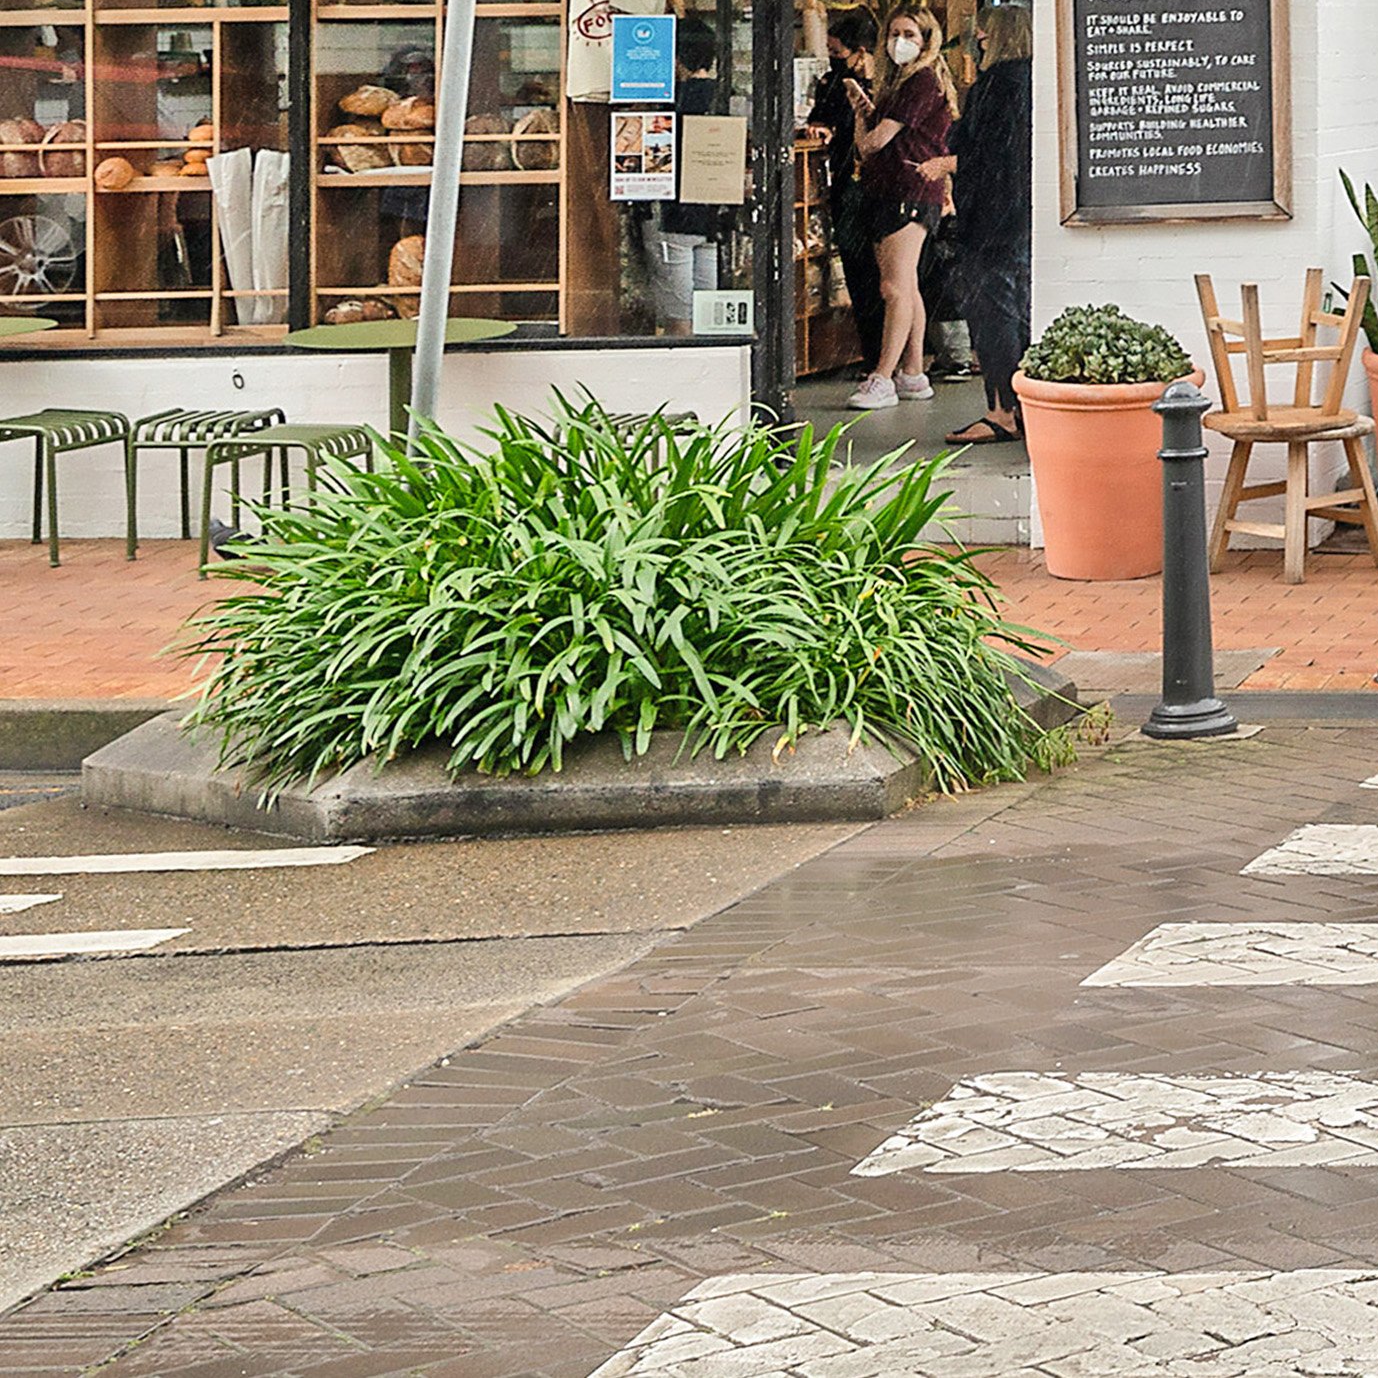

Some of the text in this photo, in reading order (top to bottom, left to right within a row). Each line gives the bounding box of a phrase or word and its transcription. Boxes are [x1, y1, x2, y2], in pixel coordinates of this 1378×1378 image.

[1086, 10, 1244, 26] IT SHOULD BE ENJOYABLE TO
[1086, 26, 1107, 38] EAT
[1086, 42, 1125, 55] SIMPLE
[1130, 42, 1141, 53] IS
[1087, 54, 1257, 72] SOURCED SUSTAINABLY, TO CARE
[1088, 71, 1108, 82] FOR
[1110, 70, 1130, 81] OUR
[1088, 86, 1115, 97] KEEP
[1118, 85, 1129, 96] IT
[1164, 83, 1195, 94] AVOID
[1197, 81, 1261, 93] COMMERCIAL
[1145, 103, 1190, 115] REFINED
[1089, 116, 1249, 133] SUPPORTS BUILDING HEALTHIER
[1089, 147, 1140, 159] PROMOTES
[1142, 145, 1175, 157] LOCAL
[1177, 143, 1203, 156] FOOD
[1088, 164, 1136, 178] CREATES
